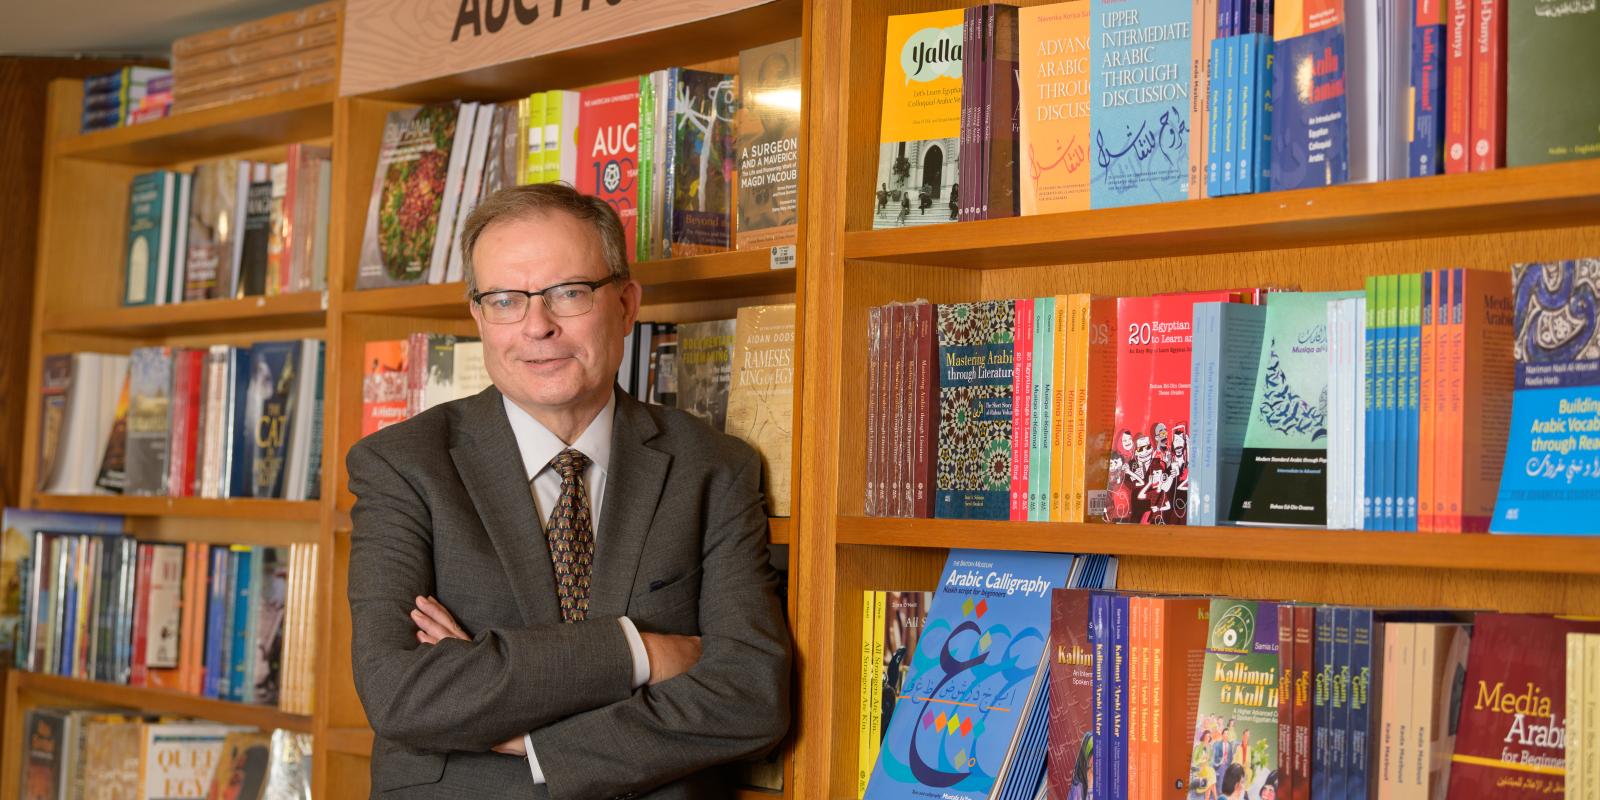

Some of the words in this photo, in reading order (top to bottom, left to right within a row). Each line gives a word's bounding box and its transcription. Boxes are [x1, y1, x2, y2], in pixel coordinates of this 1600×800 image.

[1102, 9, 1139, 28] UPPER
[1102, 22, 1190, 48] INTERMEDIATE
[1102, 46, 1155, 68] ARABIC
[1038, 58, 1088, 78] ARABIC
[1102, 64, 1178, 88] THROUGH
[926, 88, 942, 96] Learn
[936, 97, 952, 105] Arabic
[1102, 82, 1188, 108] DISCUSSION
[592, 122, 637, 157] AUC
[1309, 127, 1328, 138] Egyptian
[742, 147, 749, 160] A
[751, 137, 798, 158] SURGEON
[1309, 138, 1332, 152] Colloquial
[741, 158, 757, 170] AND
[758, 158, 764, 166] A
[764, 151, 798, 165] MAVERICK
[1308, 154, 1324, 164] Arabic
[741, 176, 765, 188] MAGDI
[767, 170, 798, 184] YACOUB
[686, 214, 719, 226] Beyond
[747, 333, 770, 344] AIDAN
[1128, 322, 1151, 345] 20
[1152, 321, 1190, 332] Egyptian
[1152, 336, 1160, 344] to
[1162, 334, 1182, 343] Learn
[744, 348, 791, 368] RAMESES
[1292, 346, 1314, 354] Musiqa
[1399, 338, 1408, 373] Media
[946, 352, 985, 368] Mastering
[740, 368, 762, 386] KING
[948, 366, 976, 382] through
[1526, 365, 1550, 375] Nariman
[1544, 376, 1559, 384] Harb
[1032, 385, 1040, 410] Musiqa
[1042, 384, 1050, 410] Musiqa
[1398, 376, 1407, 410] Arabic
[1024, 418, 1030, 426] to
[1531, 418, 1566, 434] Arabic
[256, 416, 288, 448] CAT
[1532, 437, 1576, 455] through
[946, 570, 984, 588] Arabic
[985, 572, 1051, 598] Calligraphy
[956, 588, 970, 596] script
[980, 590, 1006, 598] beginners
[906, 616, 919, 628] All
[1255, 642, 1271, 650] Samia
[1096, 644, 1104, 681] Kallimni
[1114, 644, 1122, 682] Kallimni
[872, 657, 880, 696] Strangers
[1072, 678, 1089, 686] Spoken
[1215, 661, 1274, 686] Kallimni
[1221, 685, 1231, 704] fi
[1234, 685, 1264, 706] Kull
[1474, 680, 1551, 718] Media
[1502, 747, 1518, 763] for
